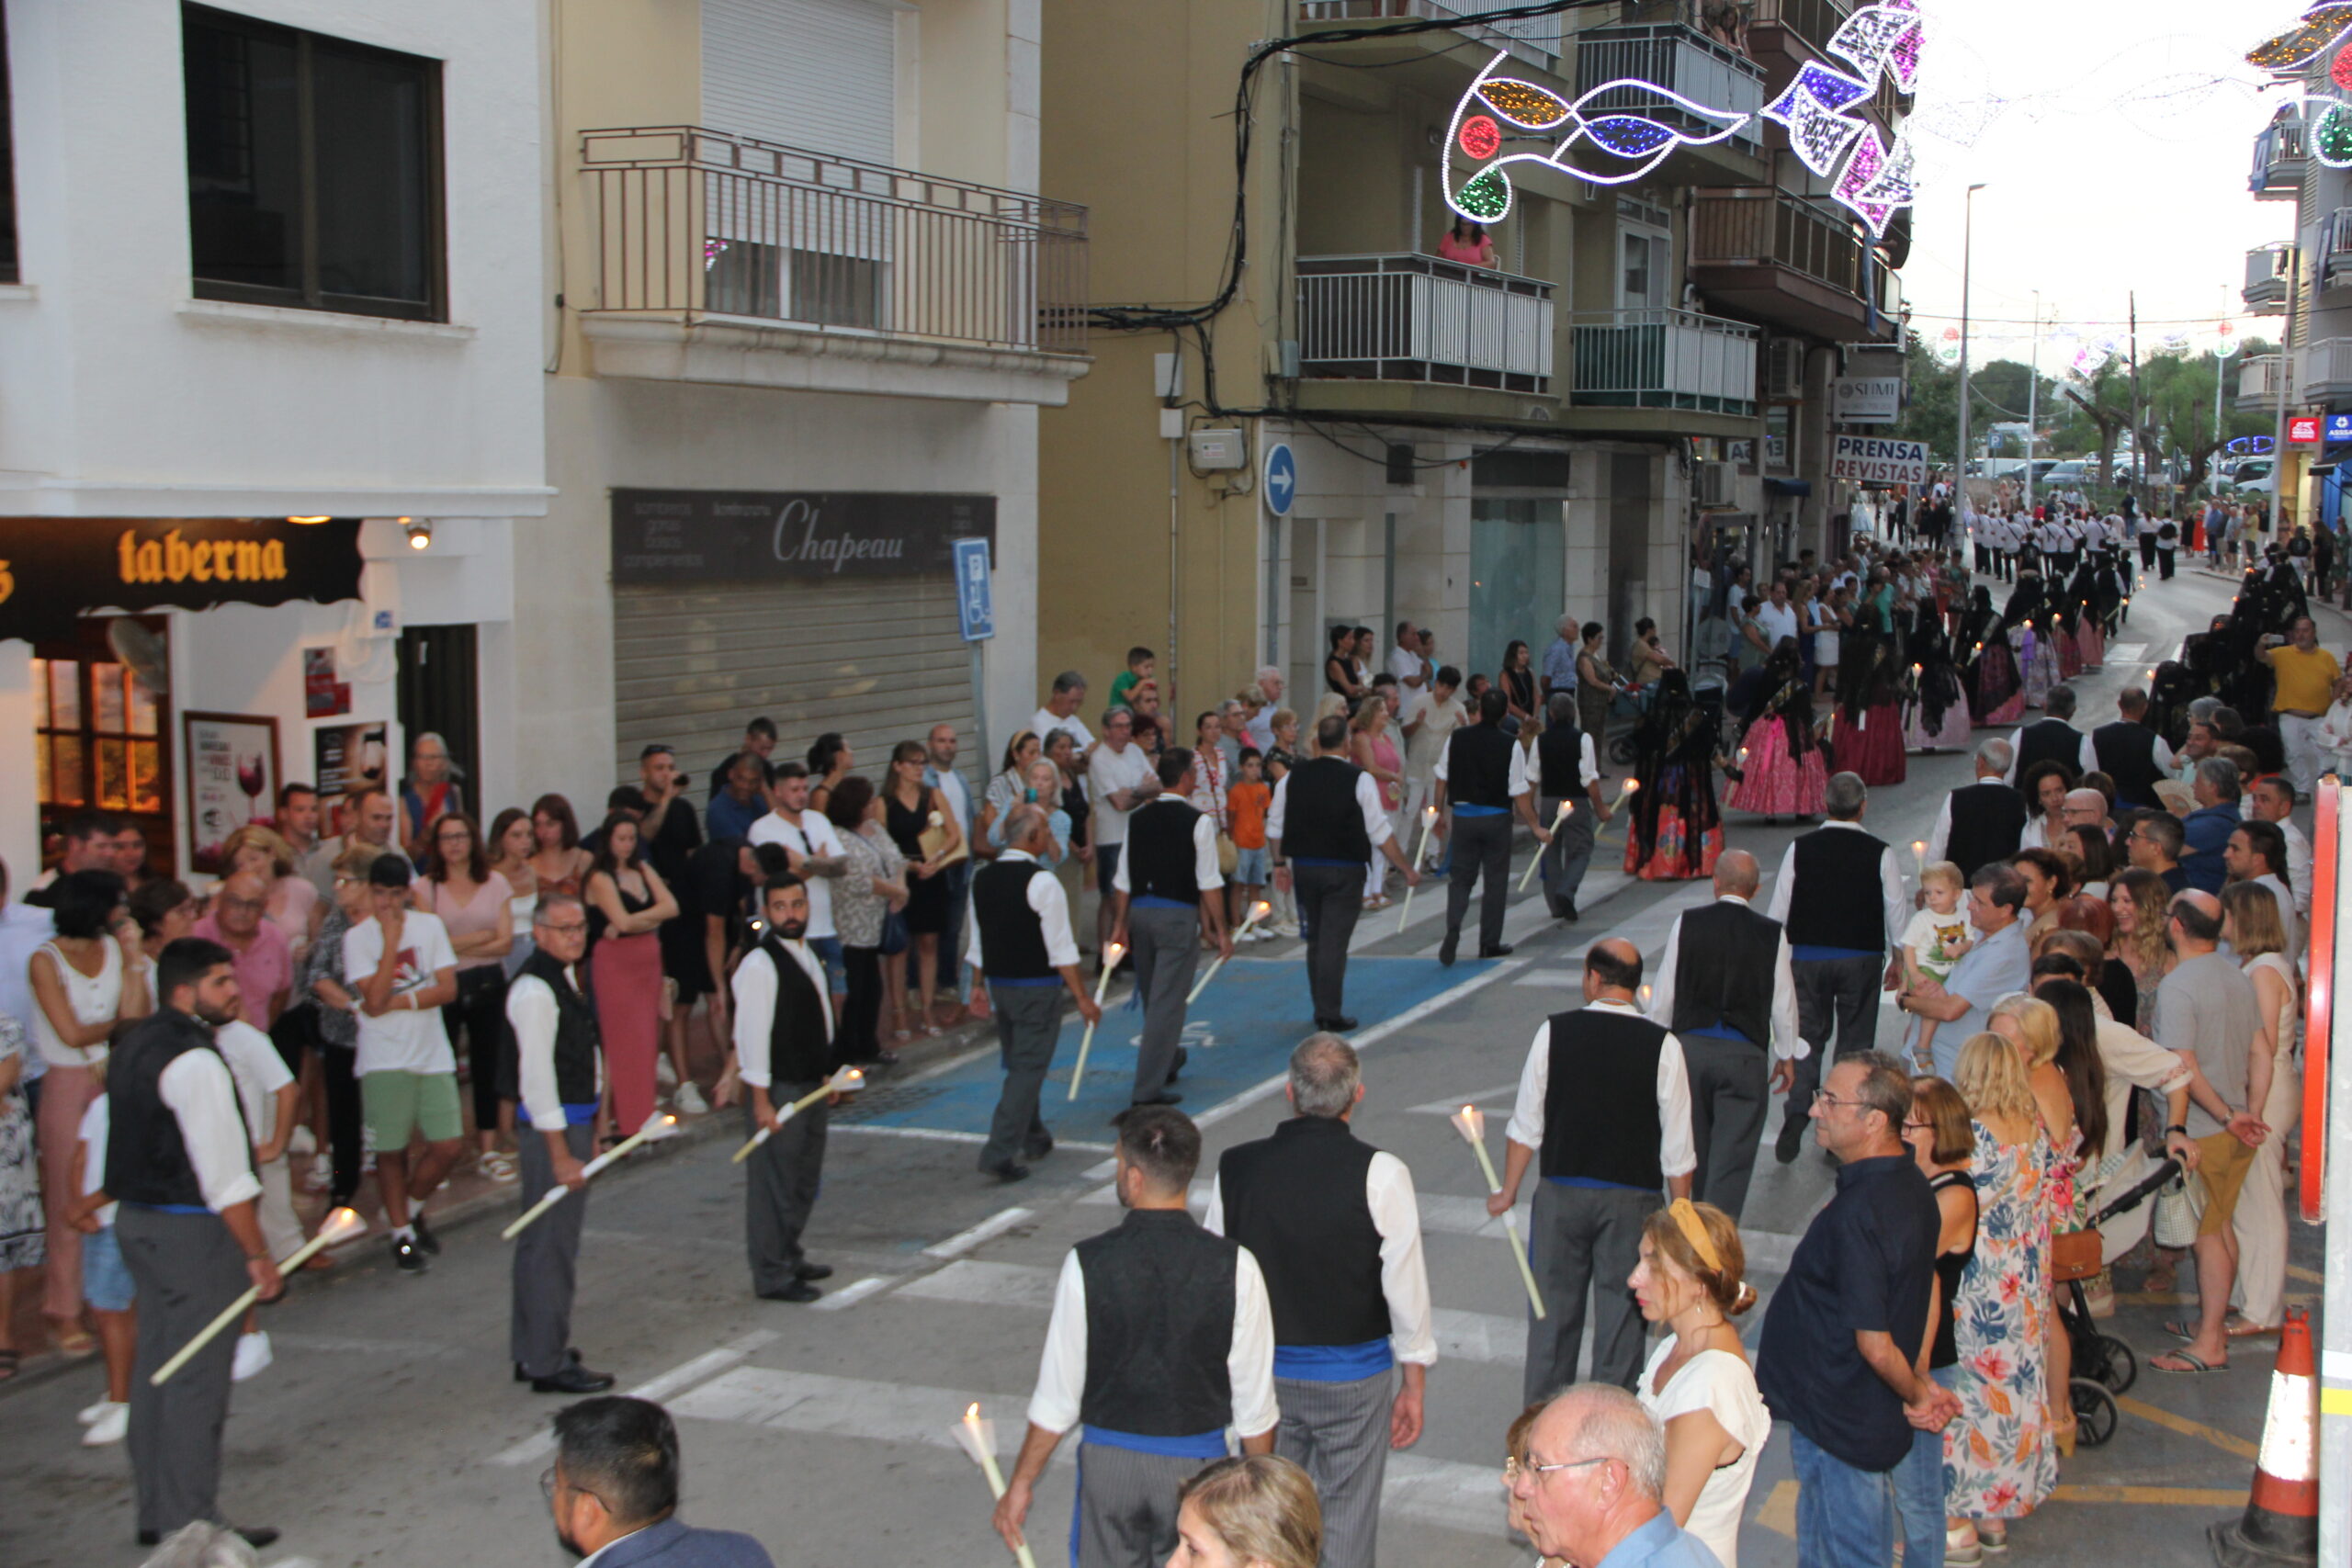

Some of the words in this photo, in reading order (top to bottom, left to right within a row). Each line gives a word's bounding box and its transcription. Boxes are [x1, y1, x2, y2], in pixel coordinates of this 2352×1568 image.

[1837, 438, 1923, 461] PRENSA
[1990, 435, 2001, 446] P
[1835, 459, 1922, 483] REVISTAS
[774, 499, 903, 573] Chapeau
[118, 529, 288, 584] taberna
